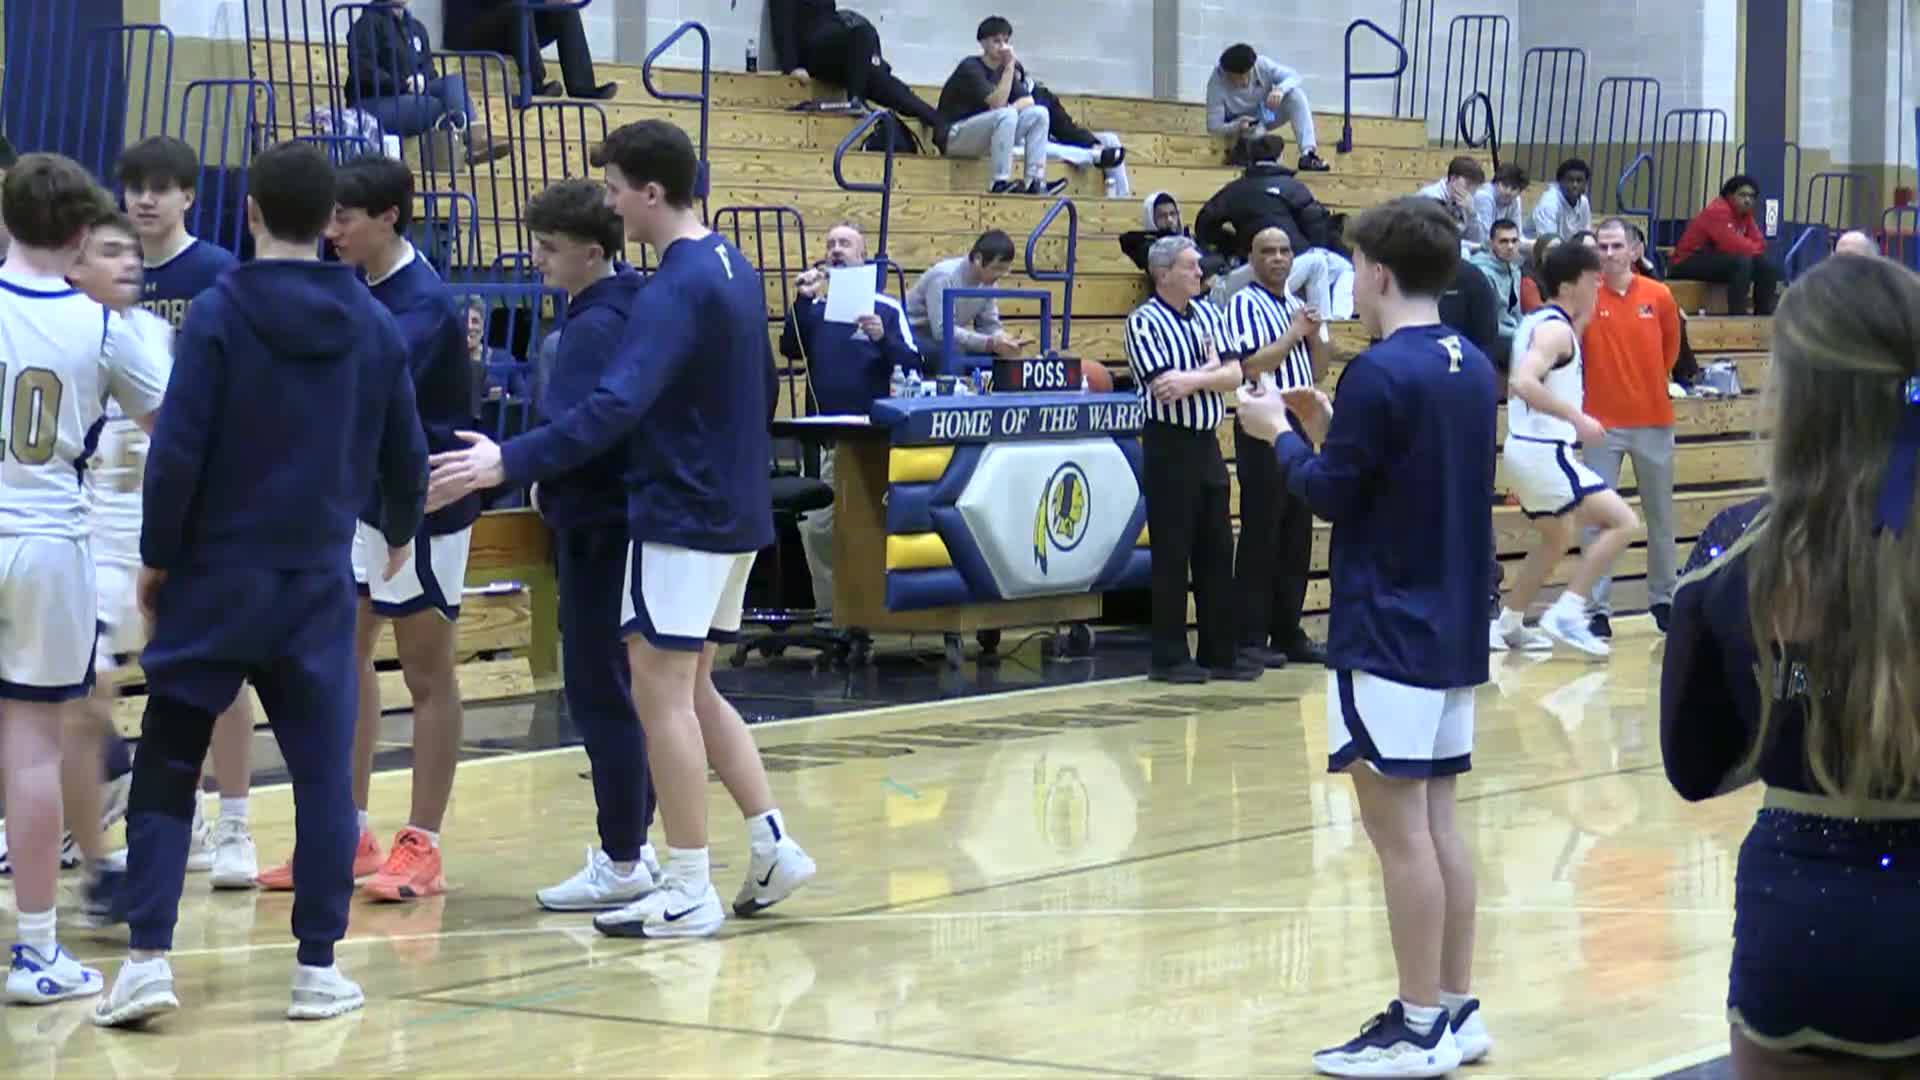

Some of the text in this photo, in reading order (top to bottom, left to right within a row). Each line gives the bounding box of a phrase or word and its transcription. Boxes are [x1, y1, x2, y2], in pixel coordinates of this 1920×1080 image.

[1022, 361, 1067, 388] POSS.
[929, 410, 993, 439] HOME
[1001, 408, 1030, 435] OF
[1039, 405, 1079, 432] THE
